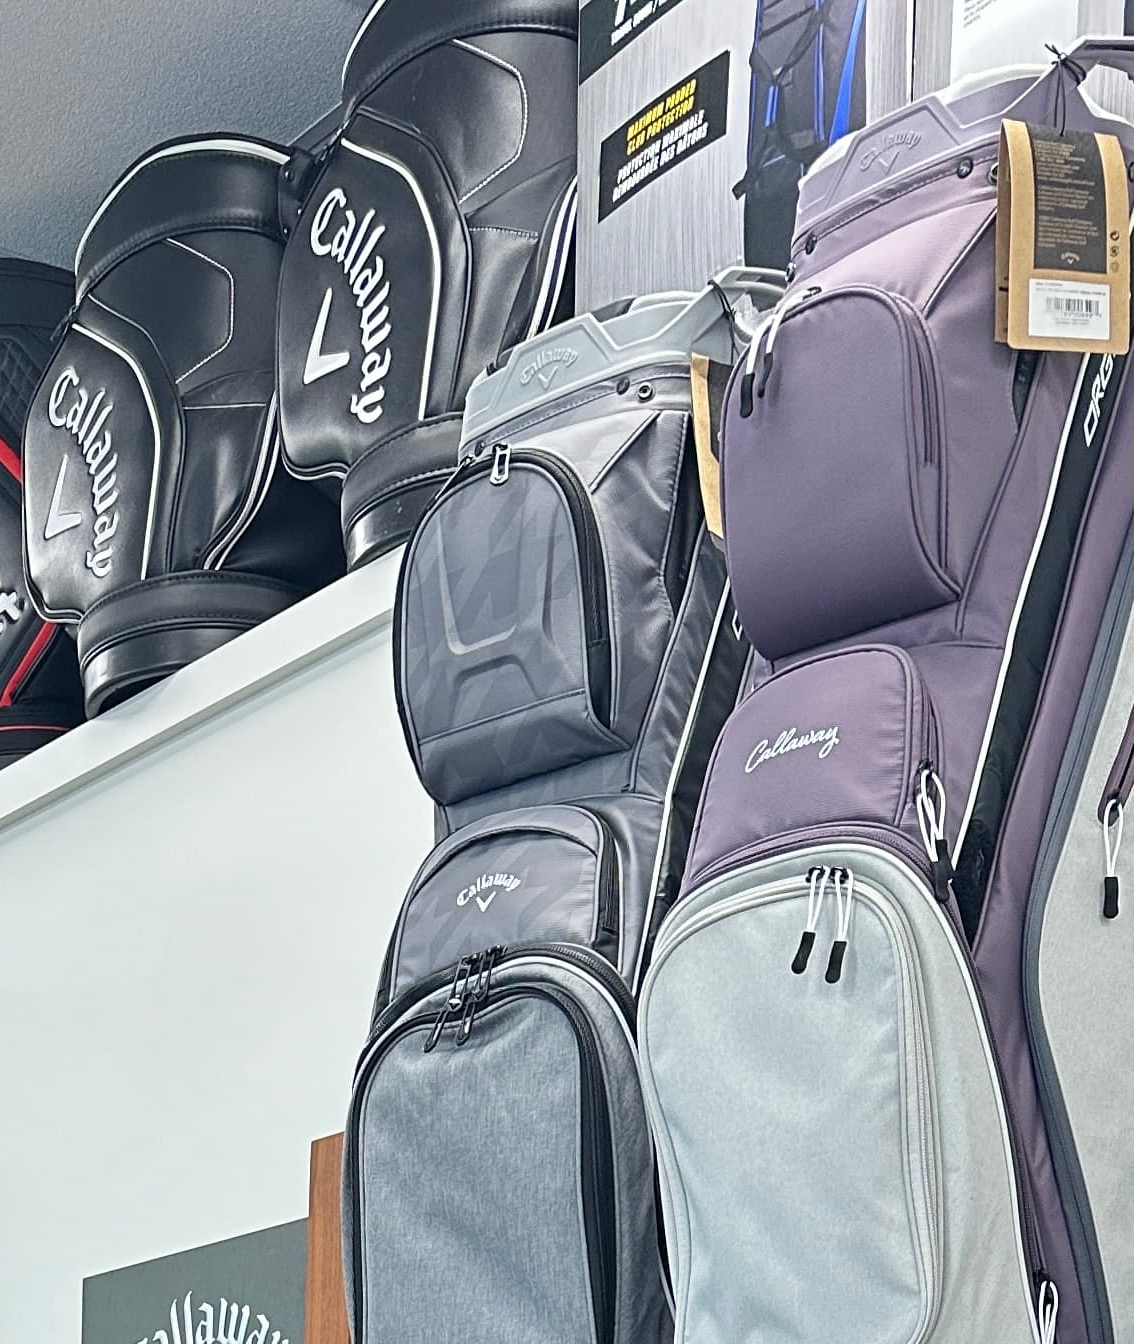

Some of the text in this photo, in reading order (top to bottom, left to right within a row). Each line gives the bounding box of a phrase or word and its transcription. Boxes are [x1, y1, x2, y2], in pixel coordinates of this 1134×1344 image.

[310, 187, 392, 424] Callaway
[520, 347, 579, 385] Callaway
[48, 366, 120, 578] Callaway
[744, 726, 840, 774] Callaway
[456, 872, 522, 907] Callaway
